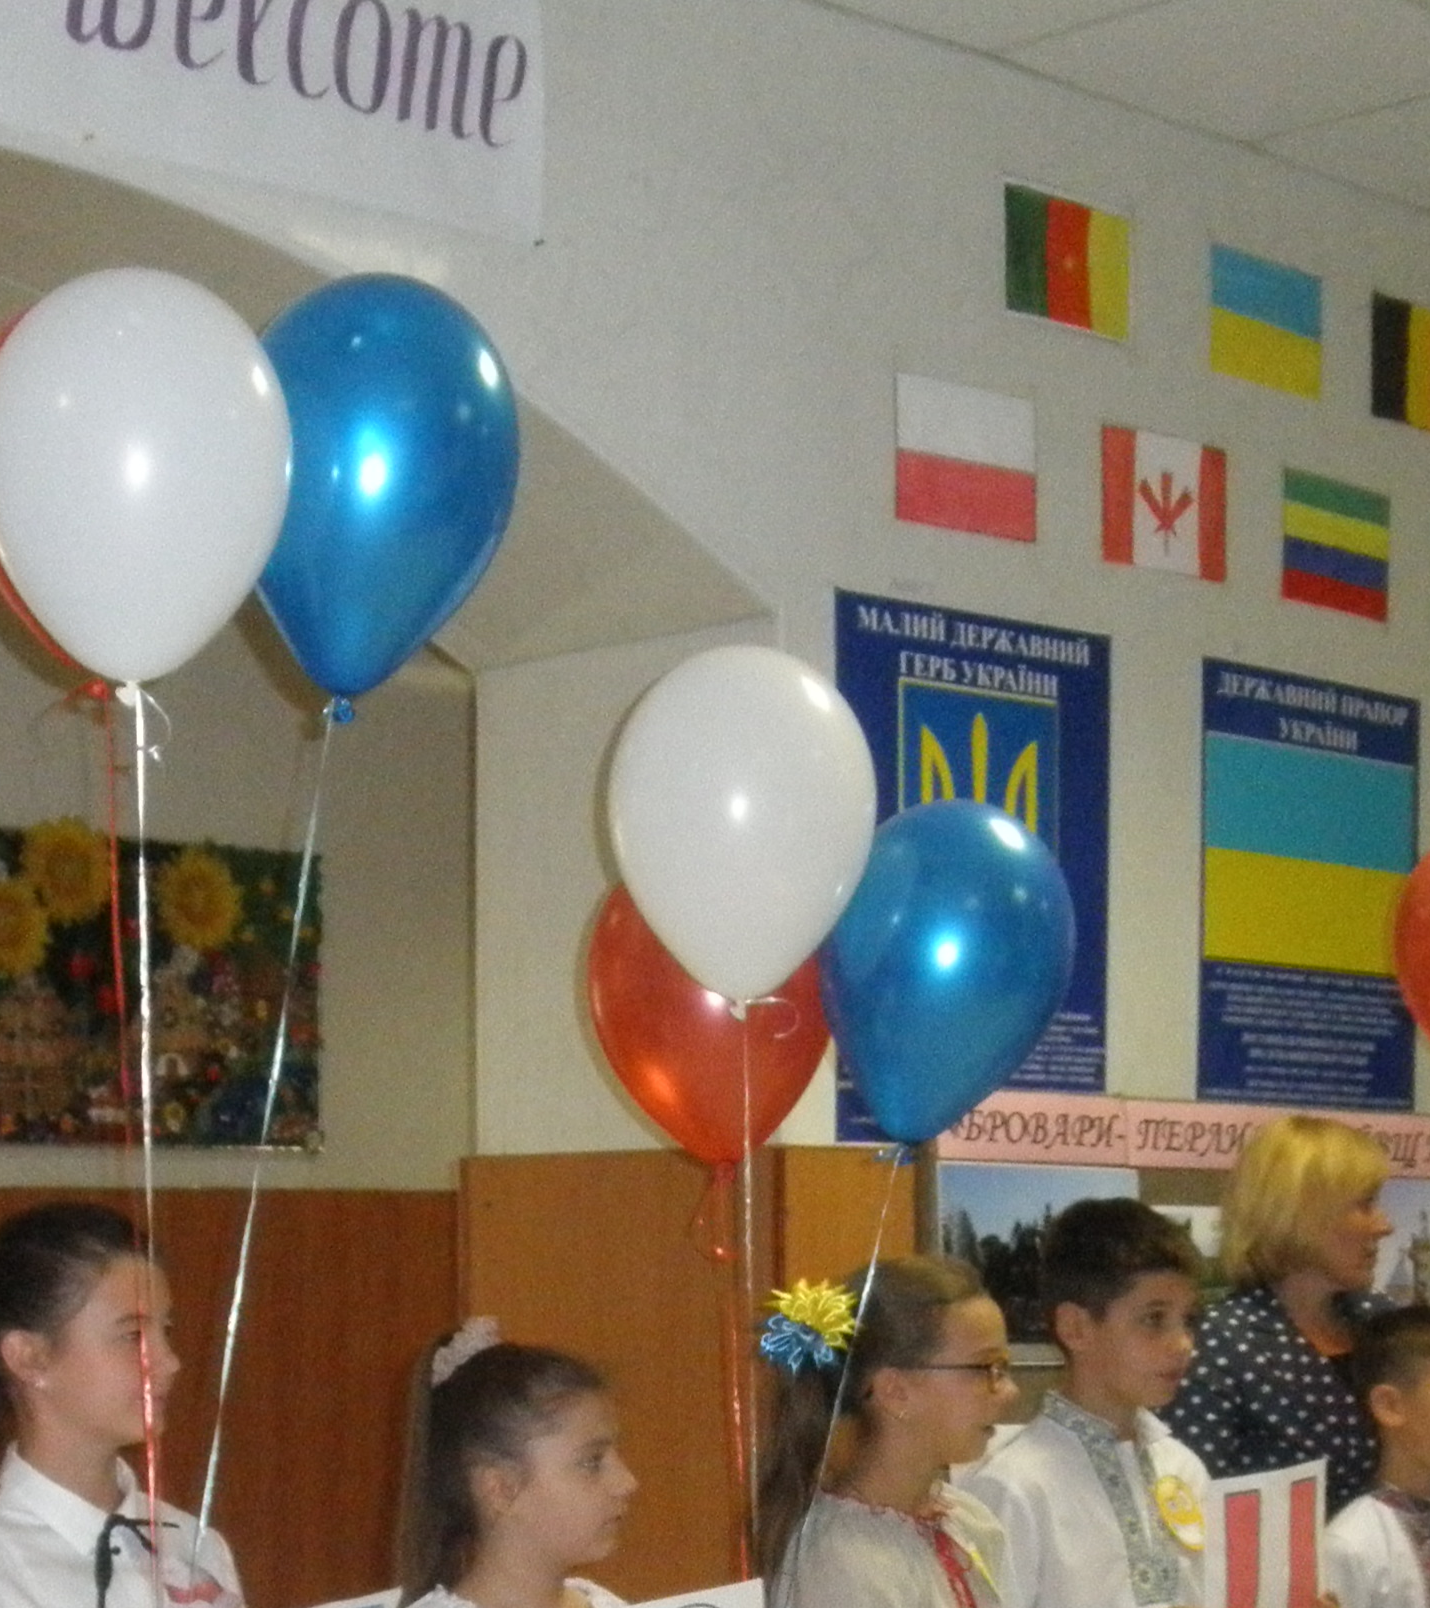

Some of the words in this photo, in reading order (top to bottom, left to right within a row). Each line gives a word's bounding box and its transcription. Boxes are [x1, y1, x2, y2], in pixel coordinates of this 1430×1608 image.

[857, 604, 946, 643] МАЛИЙ
[950, 621, 1090, 667] ДЕРЖАВНИЙ
[899, 650, 957, 681] ГЕРБ
[962, 660, 1059, 698] УКРАЇНИ
[1217, 670, 1337, 714] ДЕРЖАВНИЙ
[1340, 694, 1409, 727] ПРАПОР
[1278, 717, 1359, 751] УКРАЇНИ
